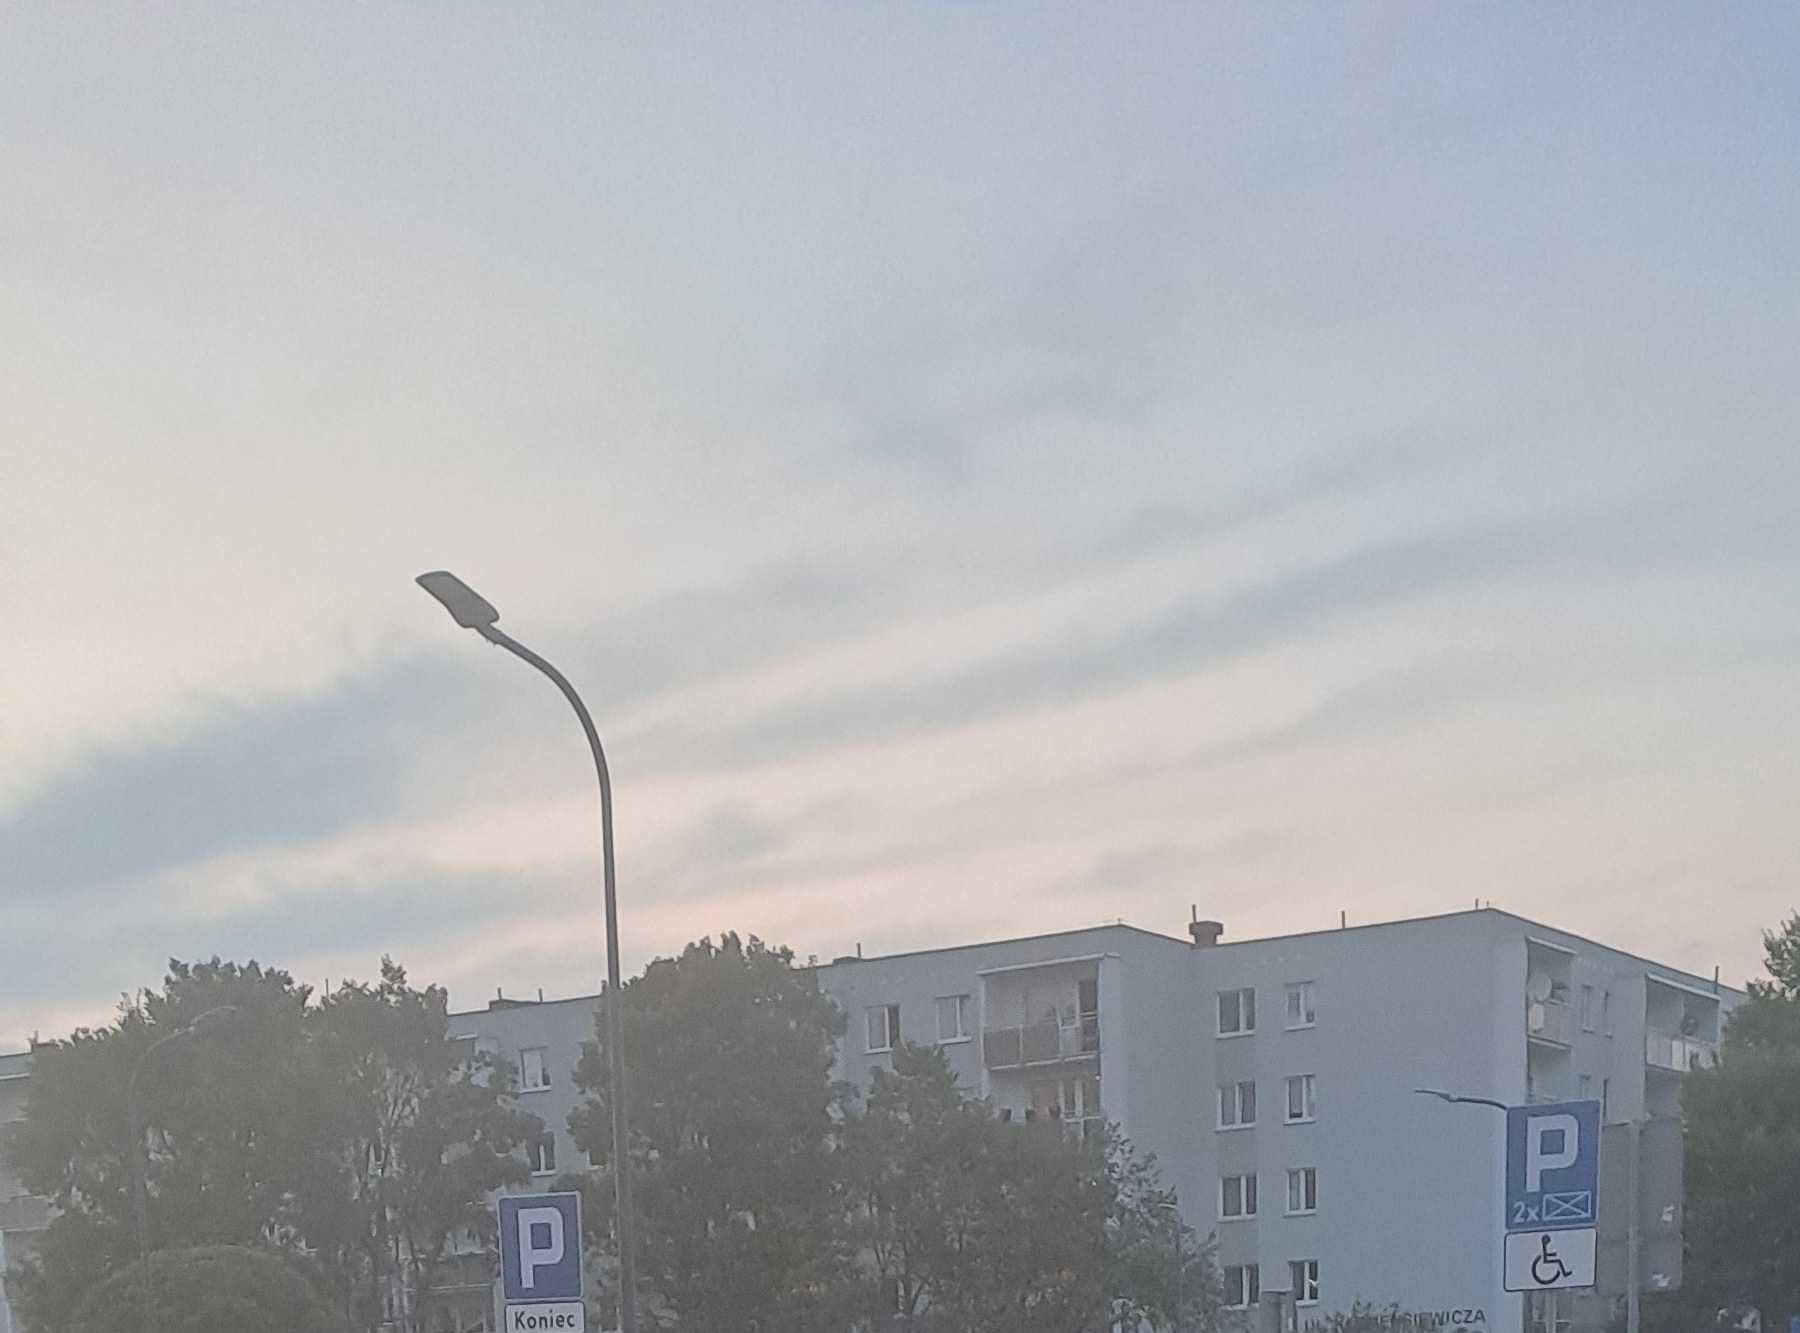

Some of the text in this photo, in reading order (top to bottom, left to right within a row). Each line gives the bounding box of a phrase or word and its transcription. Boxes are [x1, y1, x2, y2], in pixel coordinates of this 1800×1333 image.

[1526, 1114, 1578, 1193] P
[1513, 1201, 1540, 1223] 2x
[517, 1207, 564, 1288] P
[514, 1309, 576, 1331] Koniec
